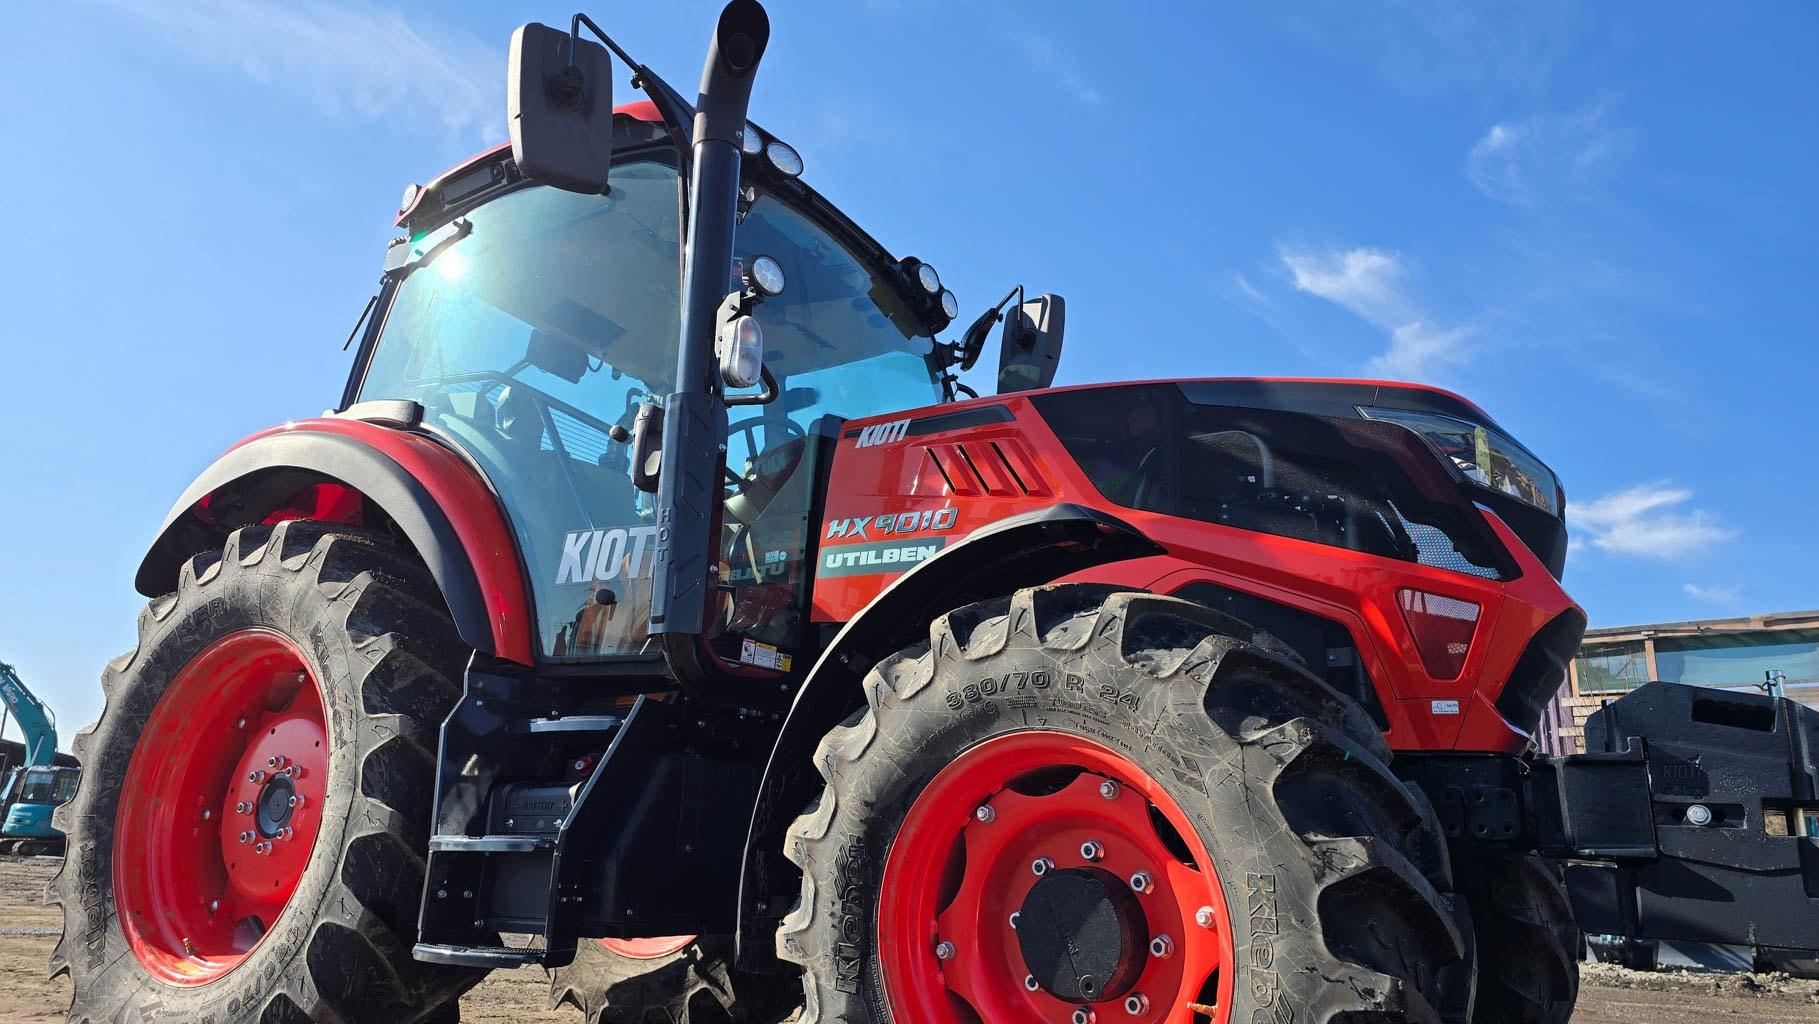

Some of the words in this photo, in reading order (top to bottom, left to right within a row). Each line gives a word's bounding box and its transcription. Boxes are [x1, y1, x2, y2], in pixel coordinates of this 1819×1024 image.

[855, 418, 911, 449] KIOTI
[657, 507, 671, 562] HOT
[826, 515, 873, 540] HX
[875, 508, 959, 535] 9010
[556, 525, 657, 585] KIOT
[826, 545, 937, 569] UTILBEN
[945, 670, 1051, 710] 380/70
[1066, 673, 1084, 694] R
[1099, 684, 1141, 713] 24
[1246, 872, 1279, 1024] Kleb
